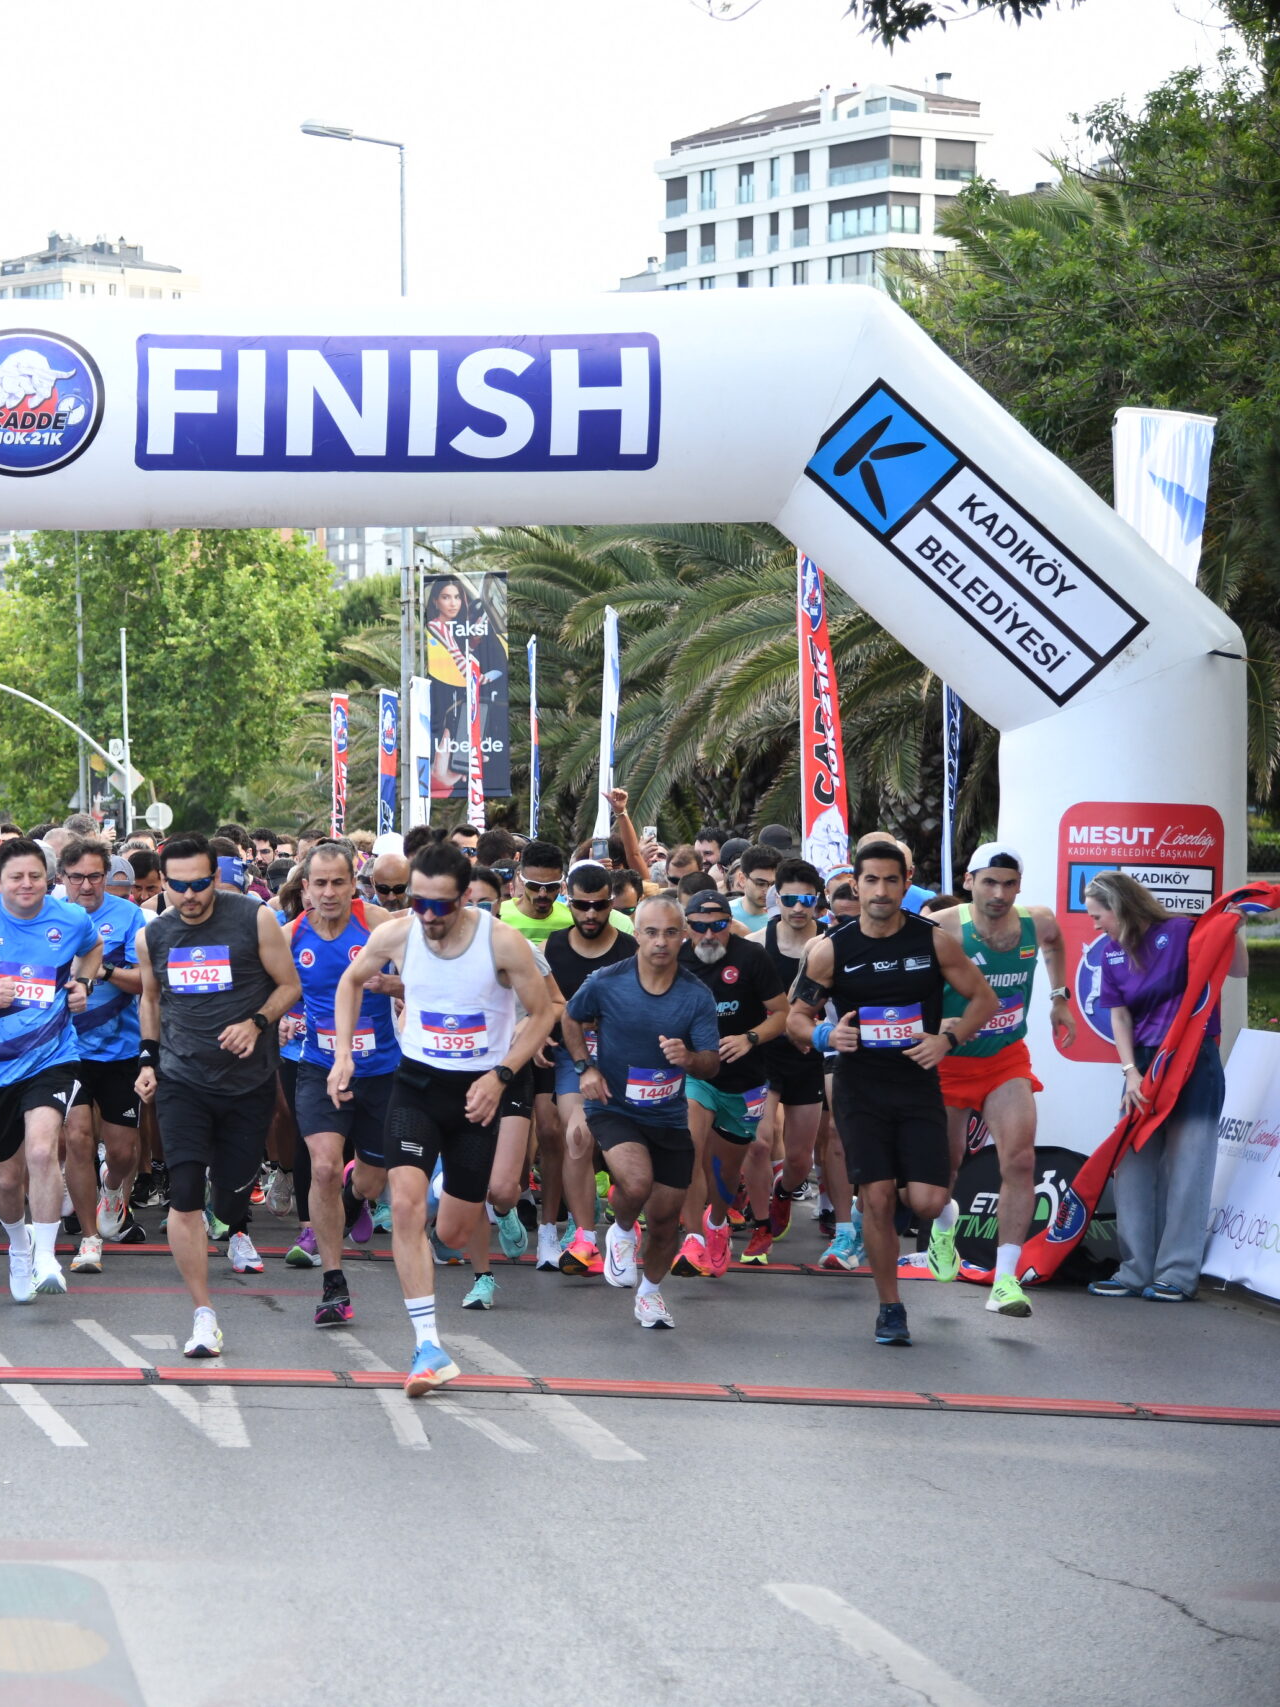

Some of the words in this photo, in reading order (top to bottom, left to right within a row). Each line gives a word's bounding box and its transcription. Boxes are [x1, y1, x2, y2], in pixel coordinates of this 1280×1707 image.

[146, 347, 649, 459] FINISH
[958, 493, 1077, 599] KADIKÖY
[915, 535, 1071, 674] BELEDİYESİ
[446, 621, 488, 638] Taksi
[1069, 826, 1155, 845] MESUT
[1068, 847, 1108, 856] KADIKÖY
[1111, 848, 1156, 858] BELEDİYE
[1160, 850, 1197, 860] BAŞKANI
[1131, 871, 1190, 885] KADIKÖY
[1158, 896, 1205, 910] EDİYESİ
[180, 968, 220, 985] 1942
[984, 971, 1028, 987] THIOPIA
[15, 984, 44, 1000] 919
[716, 1000, 740, 1013] MPO
[873, 1025, 913, 1040] 1138
[433, 1035, 475, 1050] 1395
[639, 1084, 673, 1099] 1440
[1219, 1116, 1252, 1142] MESUT
